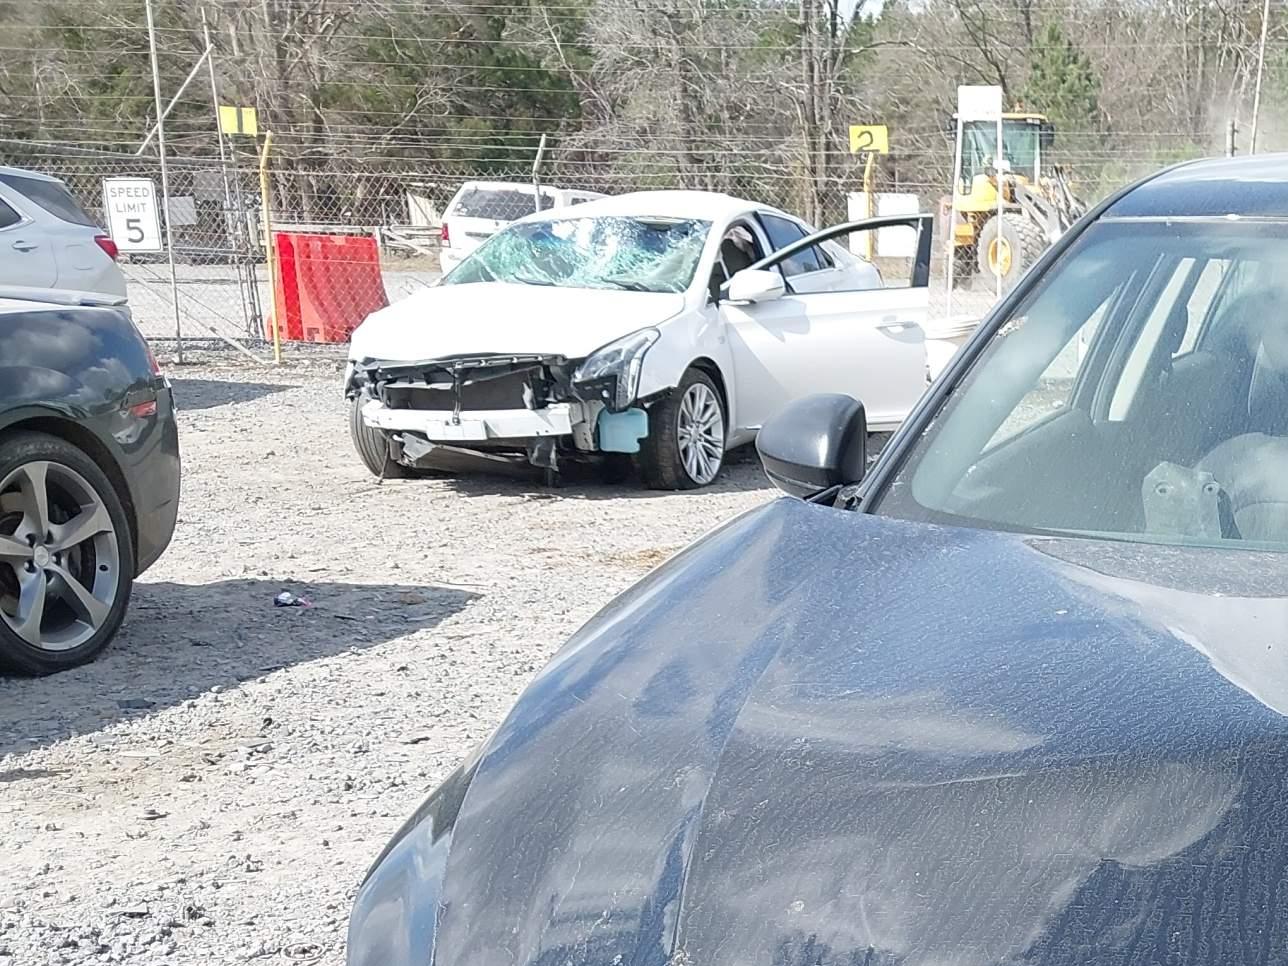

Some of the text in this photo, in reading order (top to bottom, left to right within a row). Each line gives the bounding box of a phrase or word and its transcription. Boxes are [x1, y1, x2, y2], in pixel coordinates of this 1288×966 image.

[857, 130, 881, 153] 2
[110, 187, 150, 199] SPEED
[115, 202, 147, 213] LIMIT
[126, 218, 145, 243] 5
